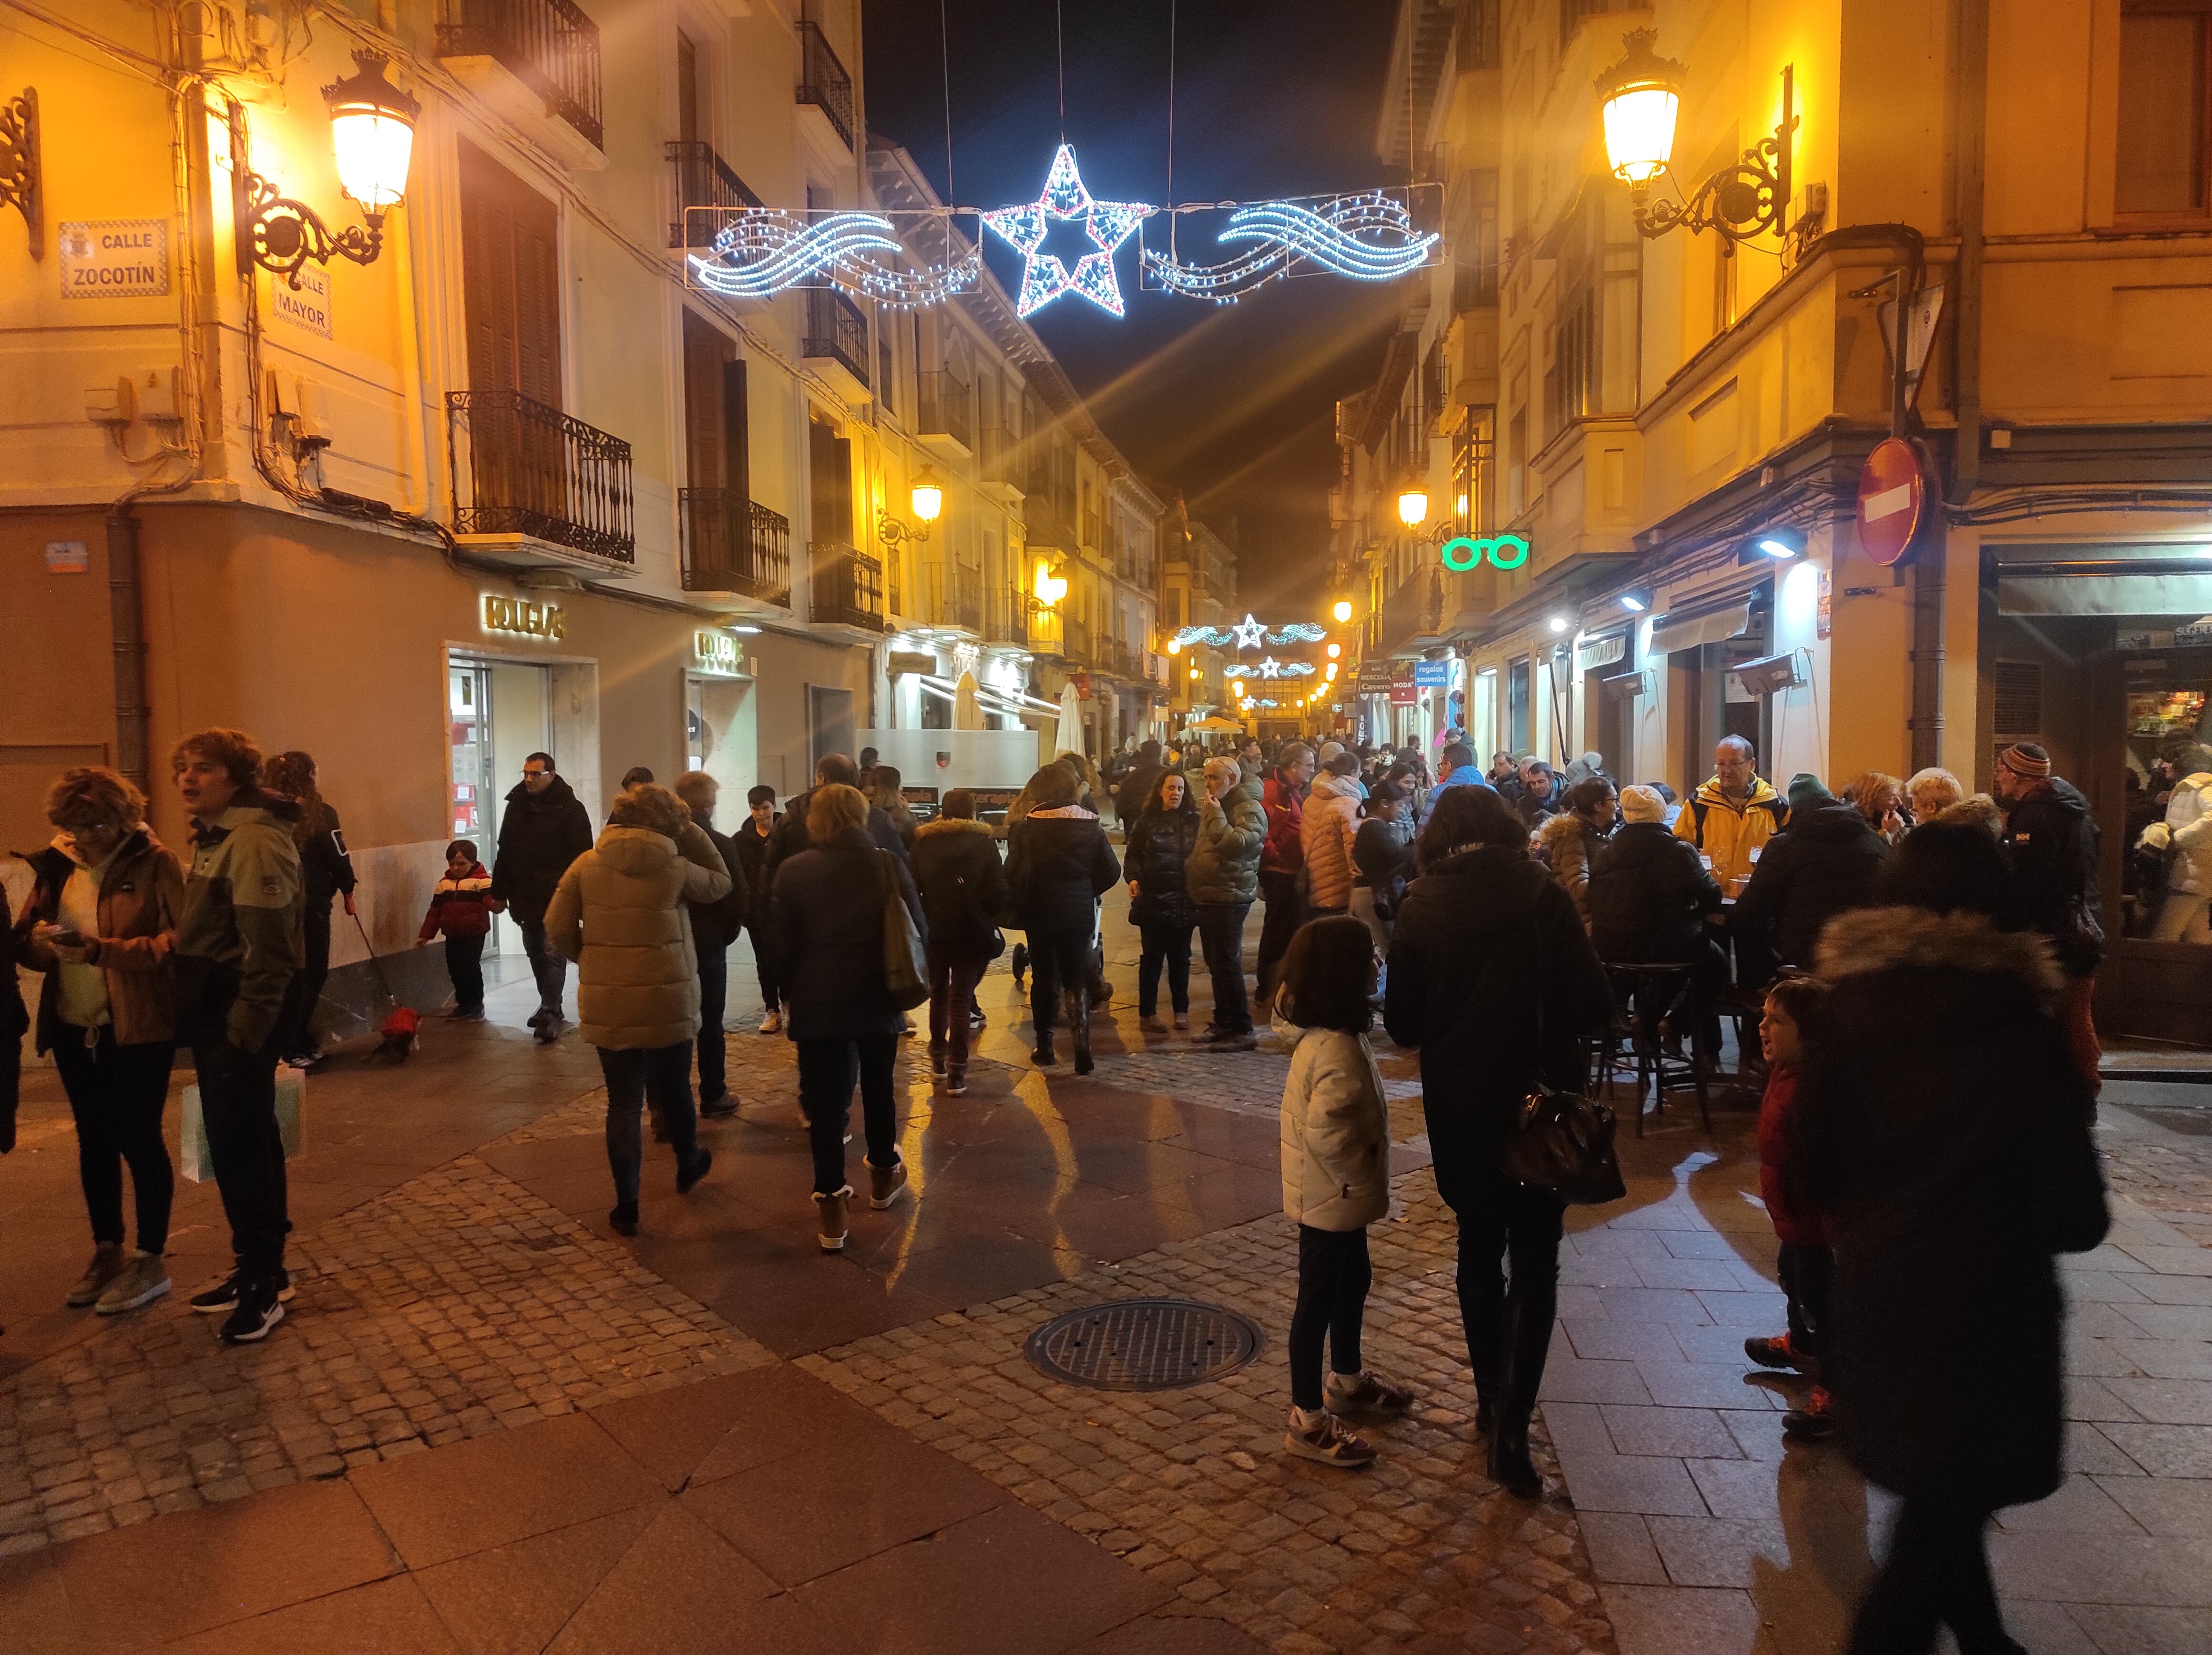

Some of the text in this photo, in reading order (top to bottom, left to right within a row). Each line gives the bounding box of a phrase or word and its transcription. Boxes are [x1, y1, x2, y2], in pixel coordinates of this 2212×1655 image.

[102, 233, 152, 249] CALLE
[74, 261, 154, 286] ZOCOTÍN
[279, 292, 325, 328] MAYOR
[1417, 674, 1446, 683] souvenirs
